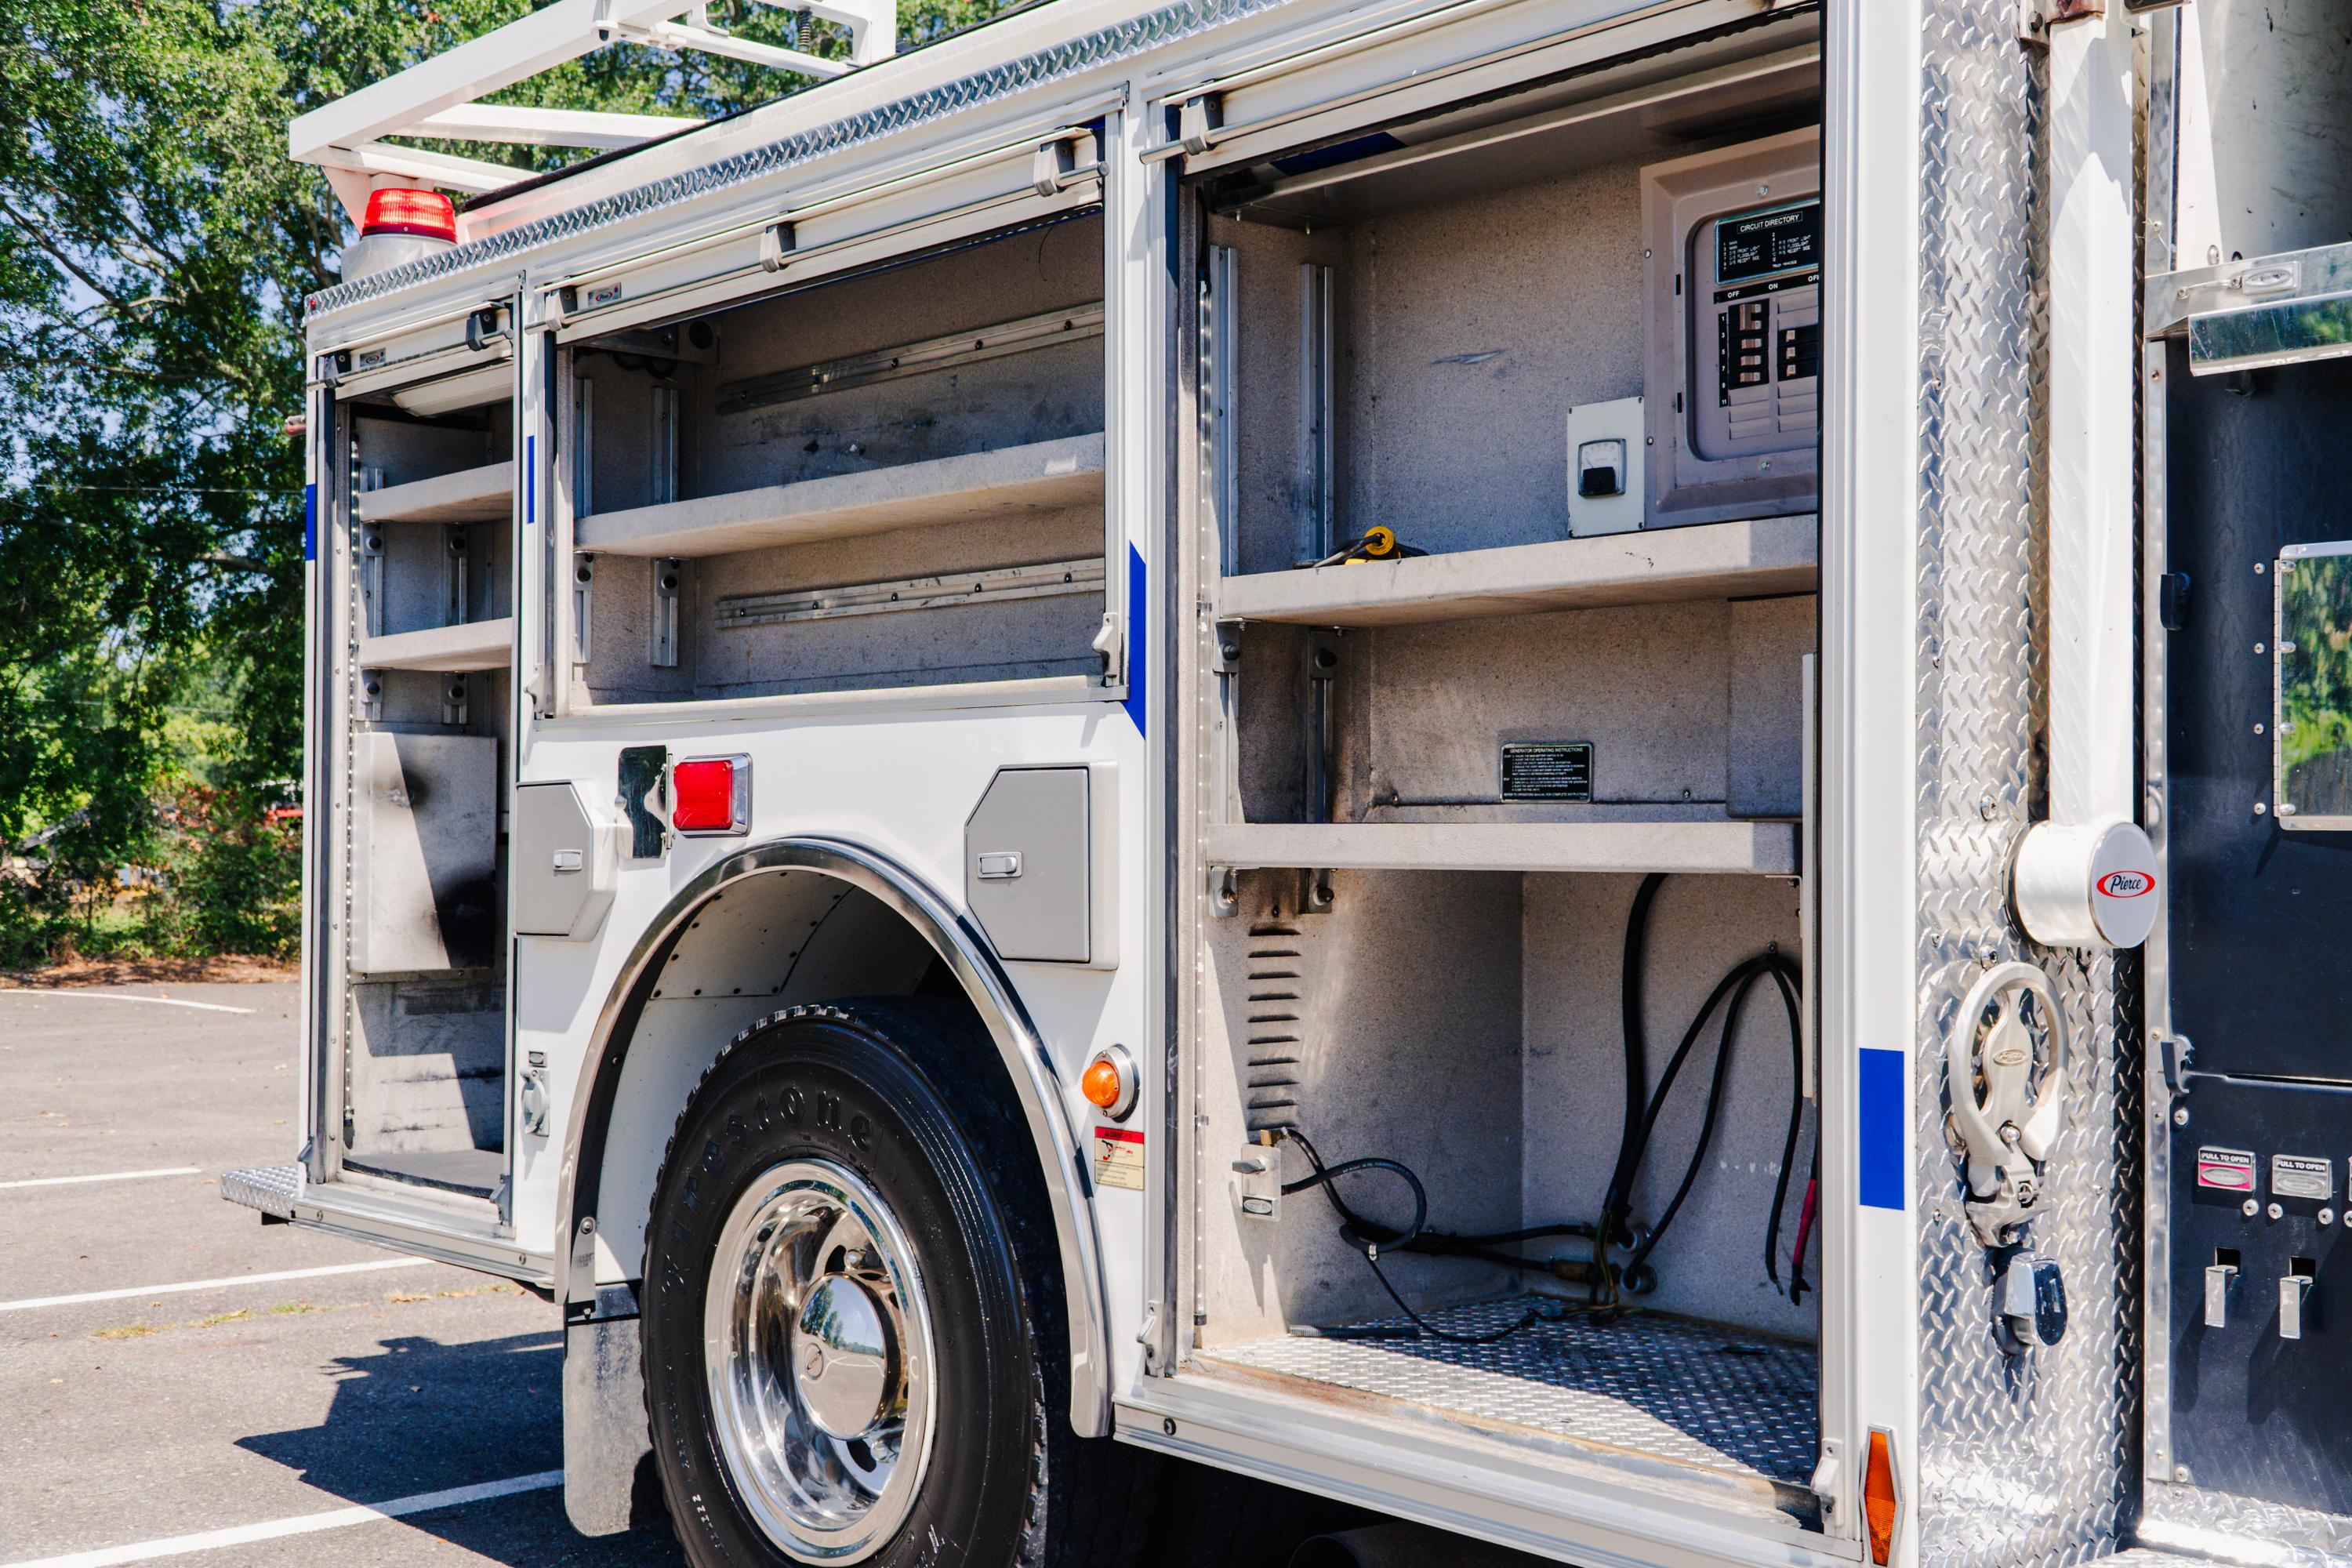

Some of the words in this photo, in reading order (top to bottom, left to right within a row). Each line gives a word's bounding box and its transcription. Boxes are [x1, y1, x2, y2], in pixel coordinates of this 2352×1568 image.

[1740, 221, 1763, 232] CIRCUIT
[1765, 214, 1799, 227] DIRECTORY
[1727, 290, 1740, 299] OFF
[2110, 874, 2142, 894] Pierce
